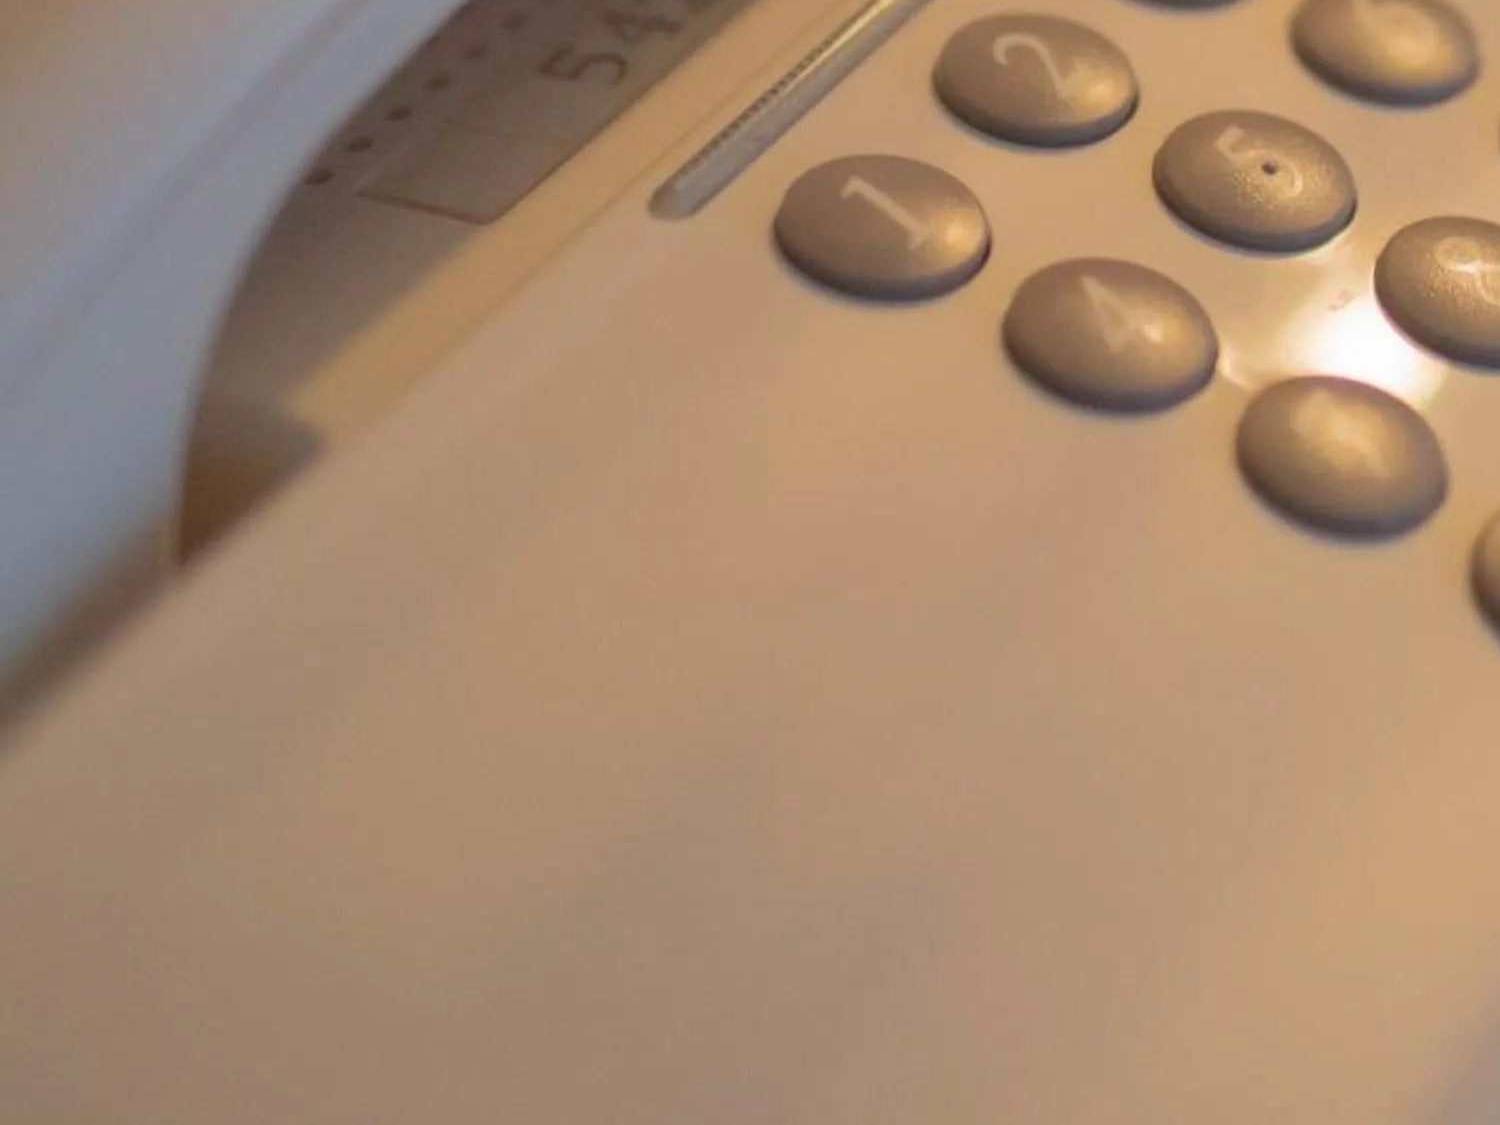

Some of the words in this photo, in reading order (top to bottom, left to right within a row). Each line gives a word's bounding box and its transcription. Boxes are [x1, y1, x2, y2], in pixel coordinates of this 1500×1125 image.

[992, 32, 1086, 97] 2
[1217, 123, 1304, 201] 5
[838, 174, 932, 251] 1
[1077, 274, 1154, 354] 4
